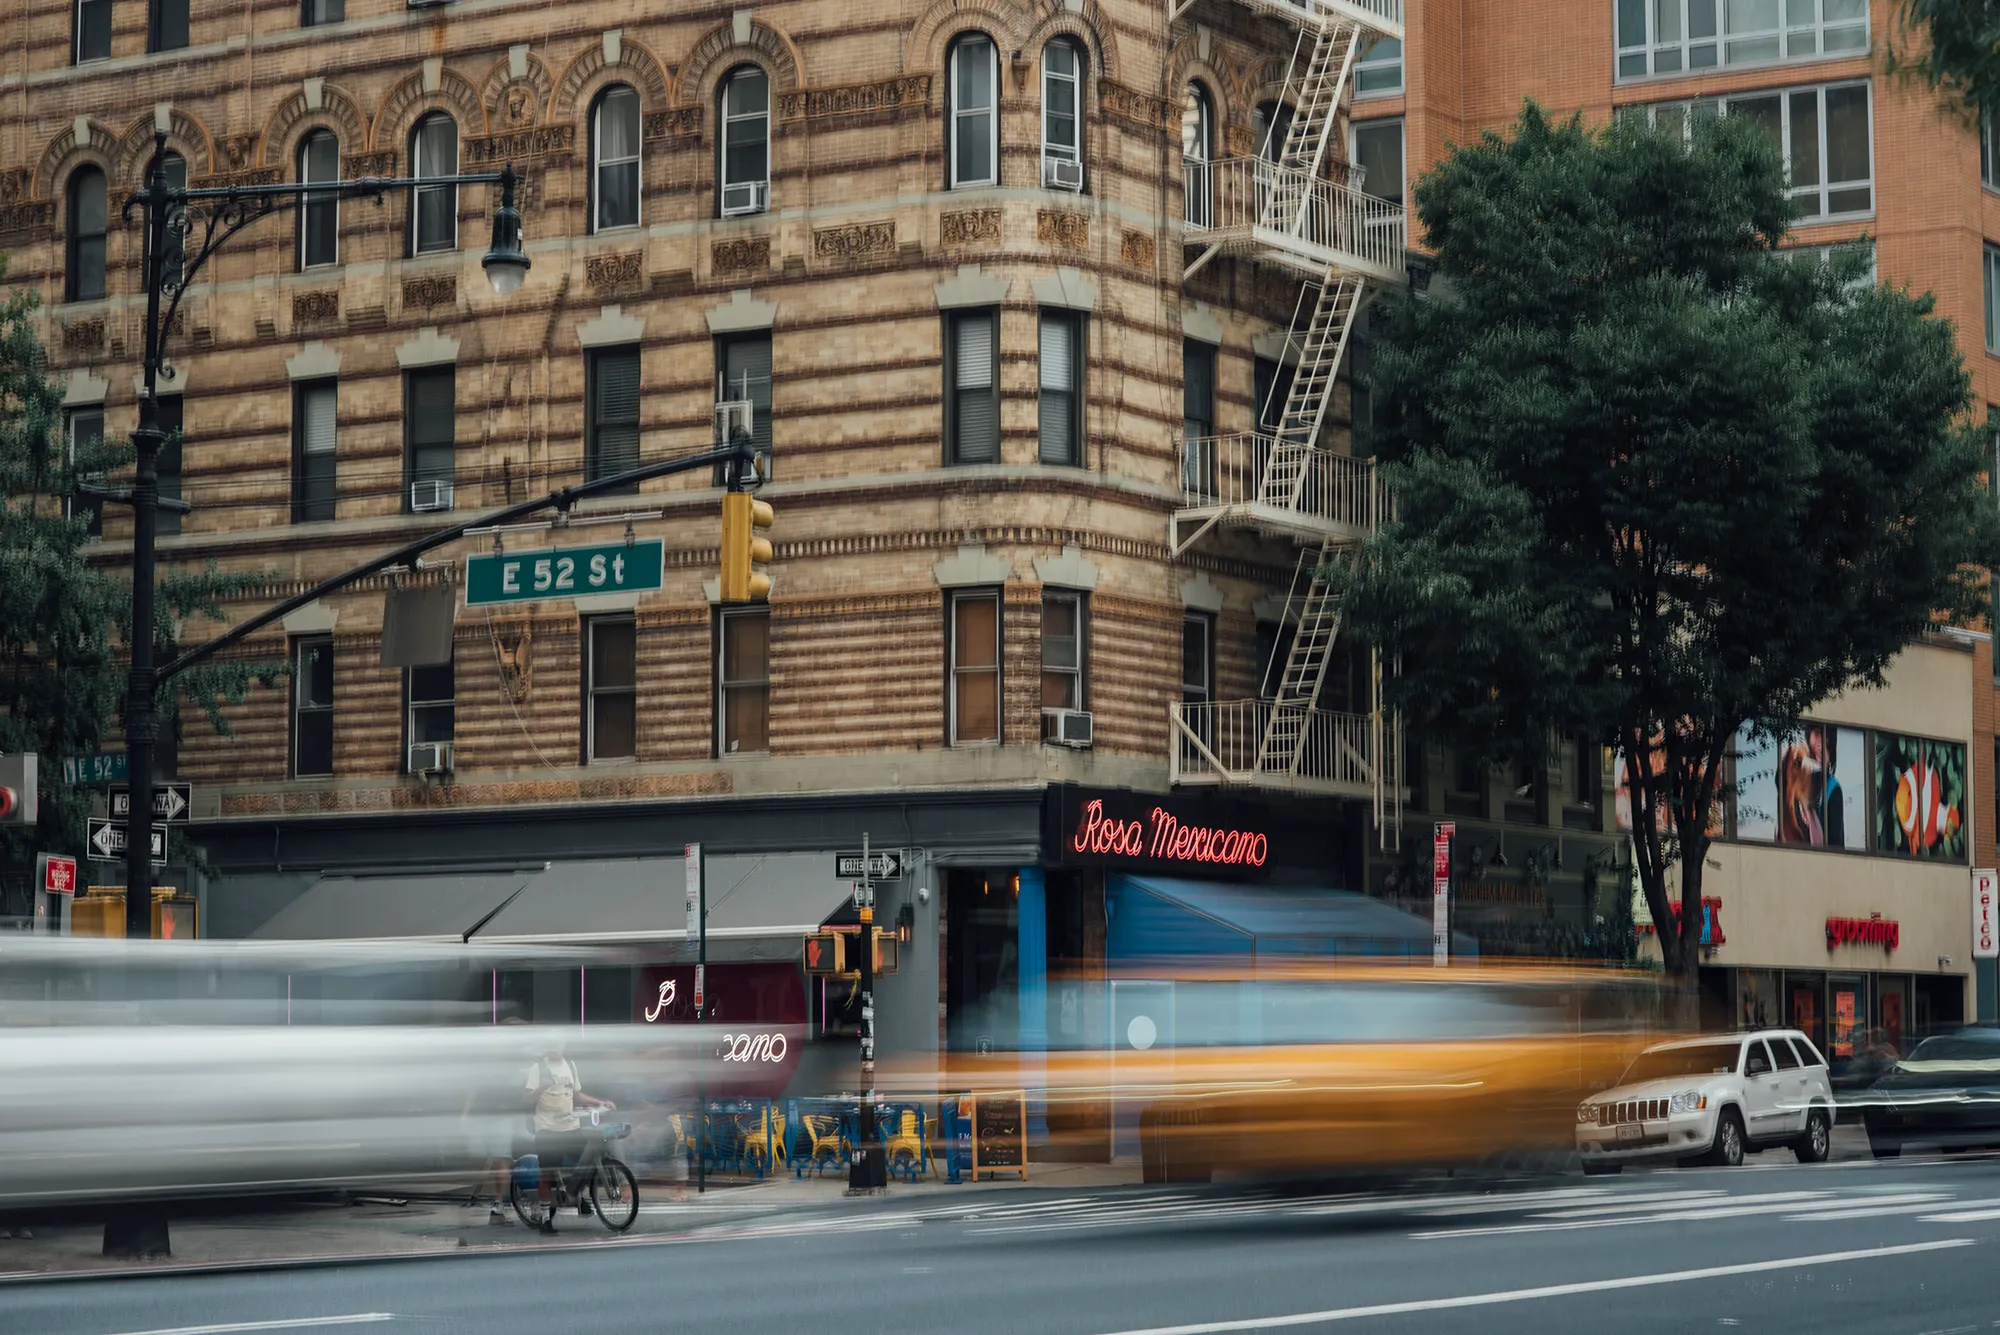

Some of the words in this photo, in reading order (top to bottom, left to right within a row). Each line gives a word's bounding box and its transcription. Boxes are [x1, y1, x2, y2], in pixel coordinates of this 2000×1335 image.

[503, 562, 520, 594] E
[534, 557, 574, 591] 52
[588, 553, 625, 587] St
[79, 758, 87, 781] E
[94, 756, 113, 780] 52
[1074, 799, 1143, 856] Rosa
[1150, 806, 1268, 867] Mexicano
[845, 859, 864, 874] ONE
[871, 858, 892, 874] WAY
[1979, 876, 1992, 950] petco
[1826, 916, 1899, 951] grooming
